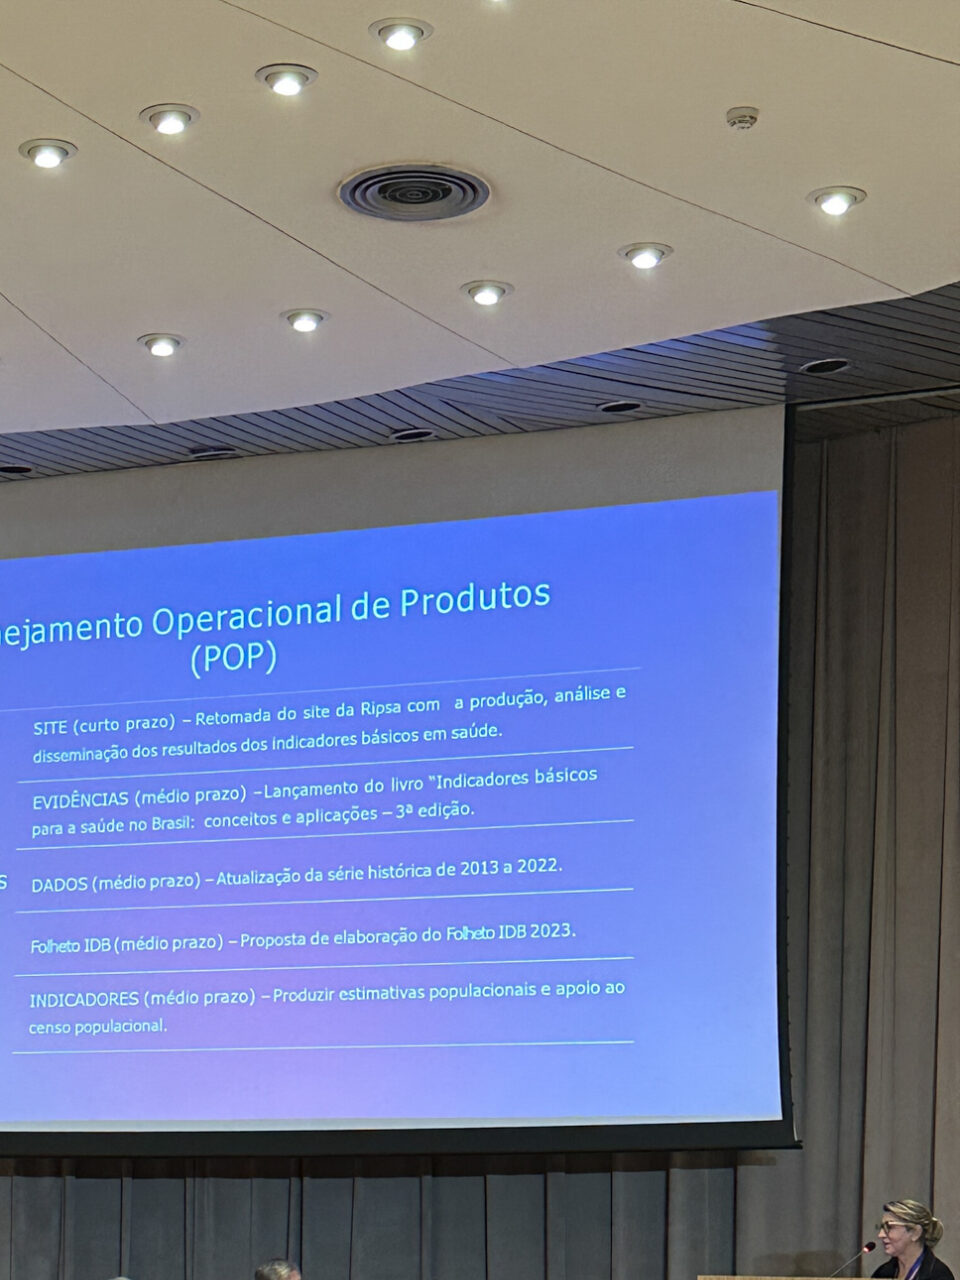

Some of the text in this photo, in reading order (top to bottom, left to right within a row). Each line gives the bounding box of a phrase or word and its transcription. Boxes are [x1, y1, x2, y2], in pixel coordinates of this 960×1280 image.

[152, 594, 341, 640] Operacional
[351, 591, 390, 621] de
[401, 581, 551, 617] Produtos
[191, 639, 277, 680] (POP)
[33, 719, 68, 736] SITE
[73, 718, 120, 737] (curto
[125, 712, 176, 734] prazo)
[195, 707, 271, 726] Retomada
[276, 705, 297, 721] do
[303, 705, 330, 720] site
[335, 701, 355, 718] da
[360, 700, 402, 718] Ripsa
[406, 699, 440, 713] com
[454, 698, 464, 710] a
[469, 688, 548, 712] produção,
[554, 684, 611, 703] análise
[615, 687, 627, 699] e
[32, 721, 503, 764] disseminação dos resultados dos indicadores básicos em saúde.
[33, 789, 129, 810] EVIDÊNCIAS
[134, 787, 190, 809] (médio
[194, 784, 247, 806] prazo)
[363, 778, 385, 794] do
[391, 776, 424, 793] livro
[534, 766, 598, 784] básicos
[32, 818, 64, 841] para
[66, 820, 76, 832] a
[80, 812, 125, 832] saúde
[128, 820, 148, 832] no
[151, 815, 195, 831] Brasil:
[203, 811, 278, 829] conceitos
[281, 813, 292, 825] e
[295, 805, 378, 827] aplicações
[417, 799, 475, 820] edição.
[31, 876, 89, 893] DADOS
[91, 874, 147, 894] (médio
[149, 871, 201, 892] prazo)
[304, 867, 323, 883] da
[327, 864, 365, 882] série
[367, 862, 432, 880] histórica
[435, 861, 456, 877] de
[460, 860, 499, 876] 2013
[503, 862, 513, 874] a
[517, 857, 563, 874] 2022.
[30, 938, 81, 954] Folheto
[83, 937, 112, 953] IDB
[113, 934, 169, 956] (médio
[172, 933, 224, 953] prazo)
[309, 930, 330, 946] de
[333, 926, 418, 947] elaboração
[421, 926, 442, 942] do
[446, 925, 496, 941] Folheto
[498, 924, 527, 940] IDB
[530, 922, 577, 939] 2023.
[30, 991, 140, 1009] INDICADORES
[144, 989, 199, 1009] (médio
[203, 987, 256, 1007] prazo)
[338, 985, 426, 1001] estimativas
[429, 981, 537, 1002] populacionais
[540, 984, 551, 996] e
[555, 979, 601, 999] apoio
[604, 982, 626, 994] ao
[28, 1017, 168, 1037] censo populacional.
